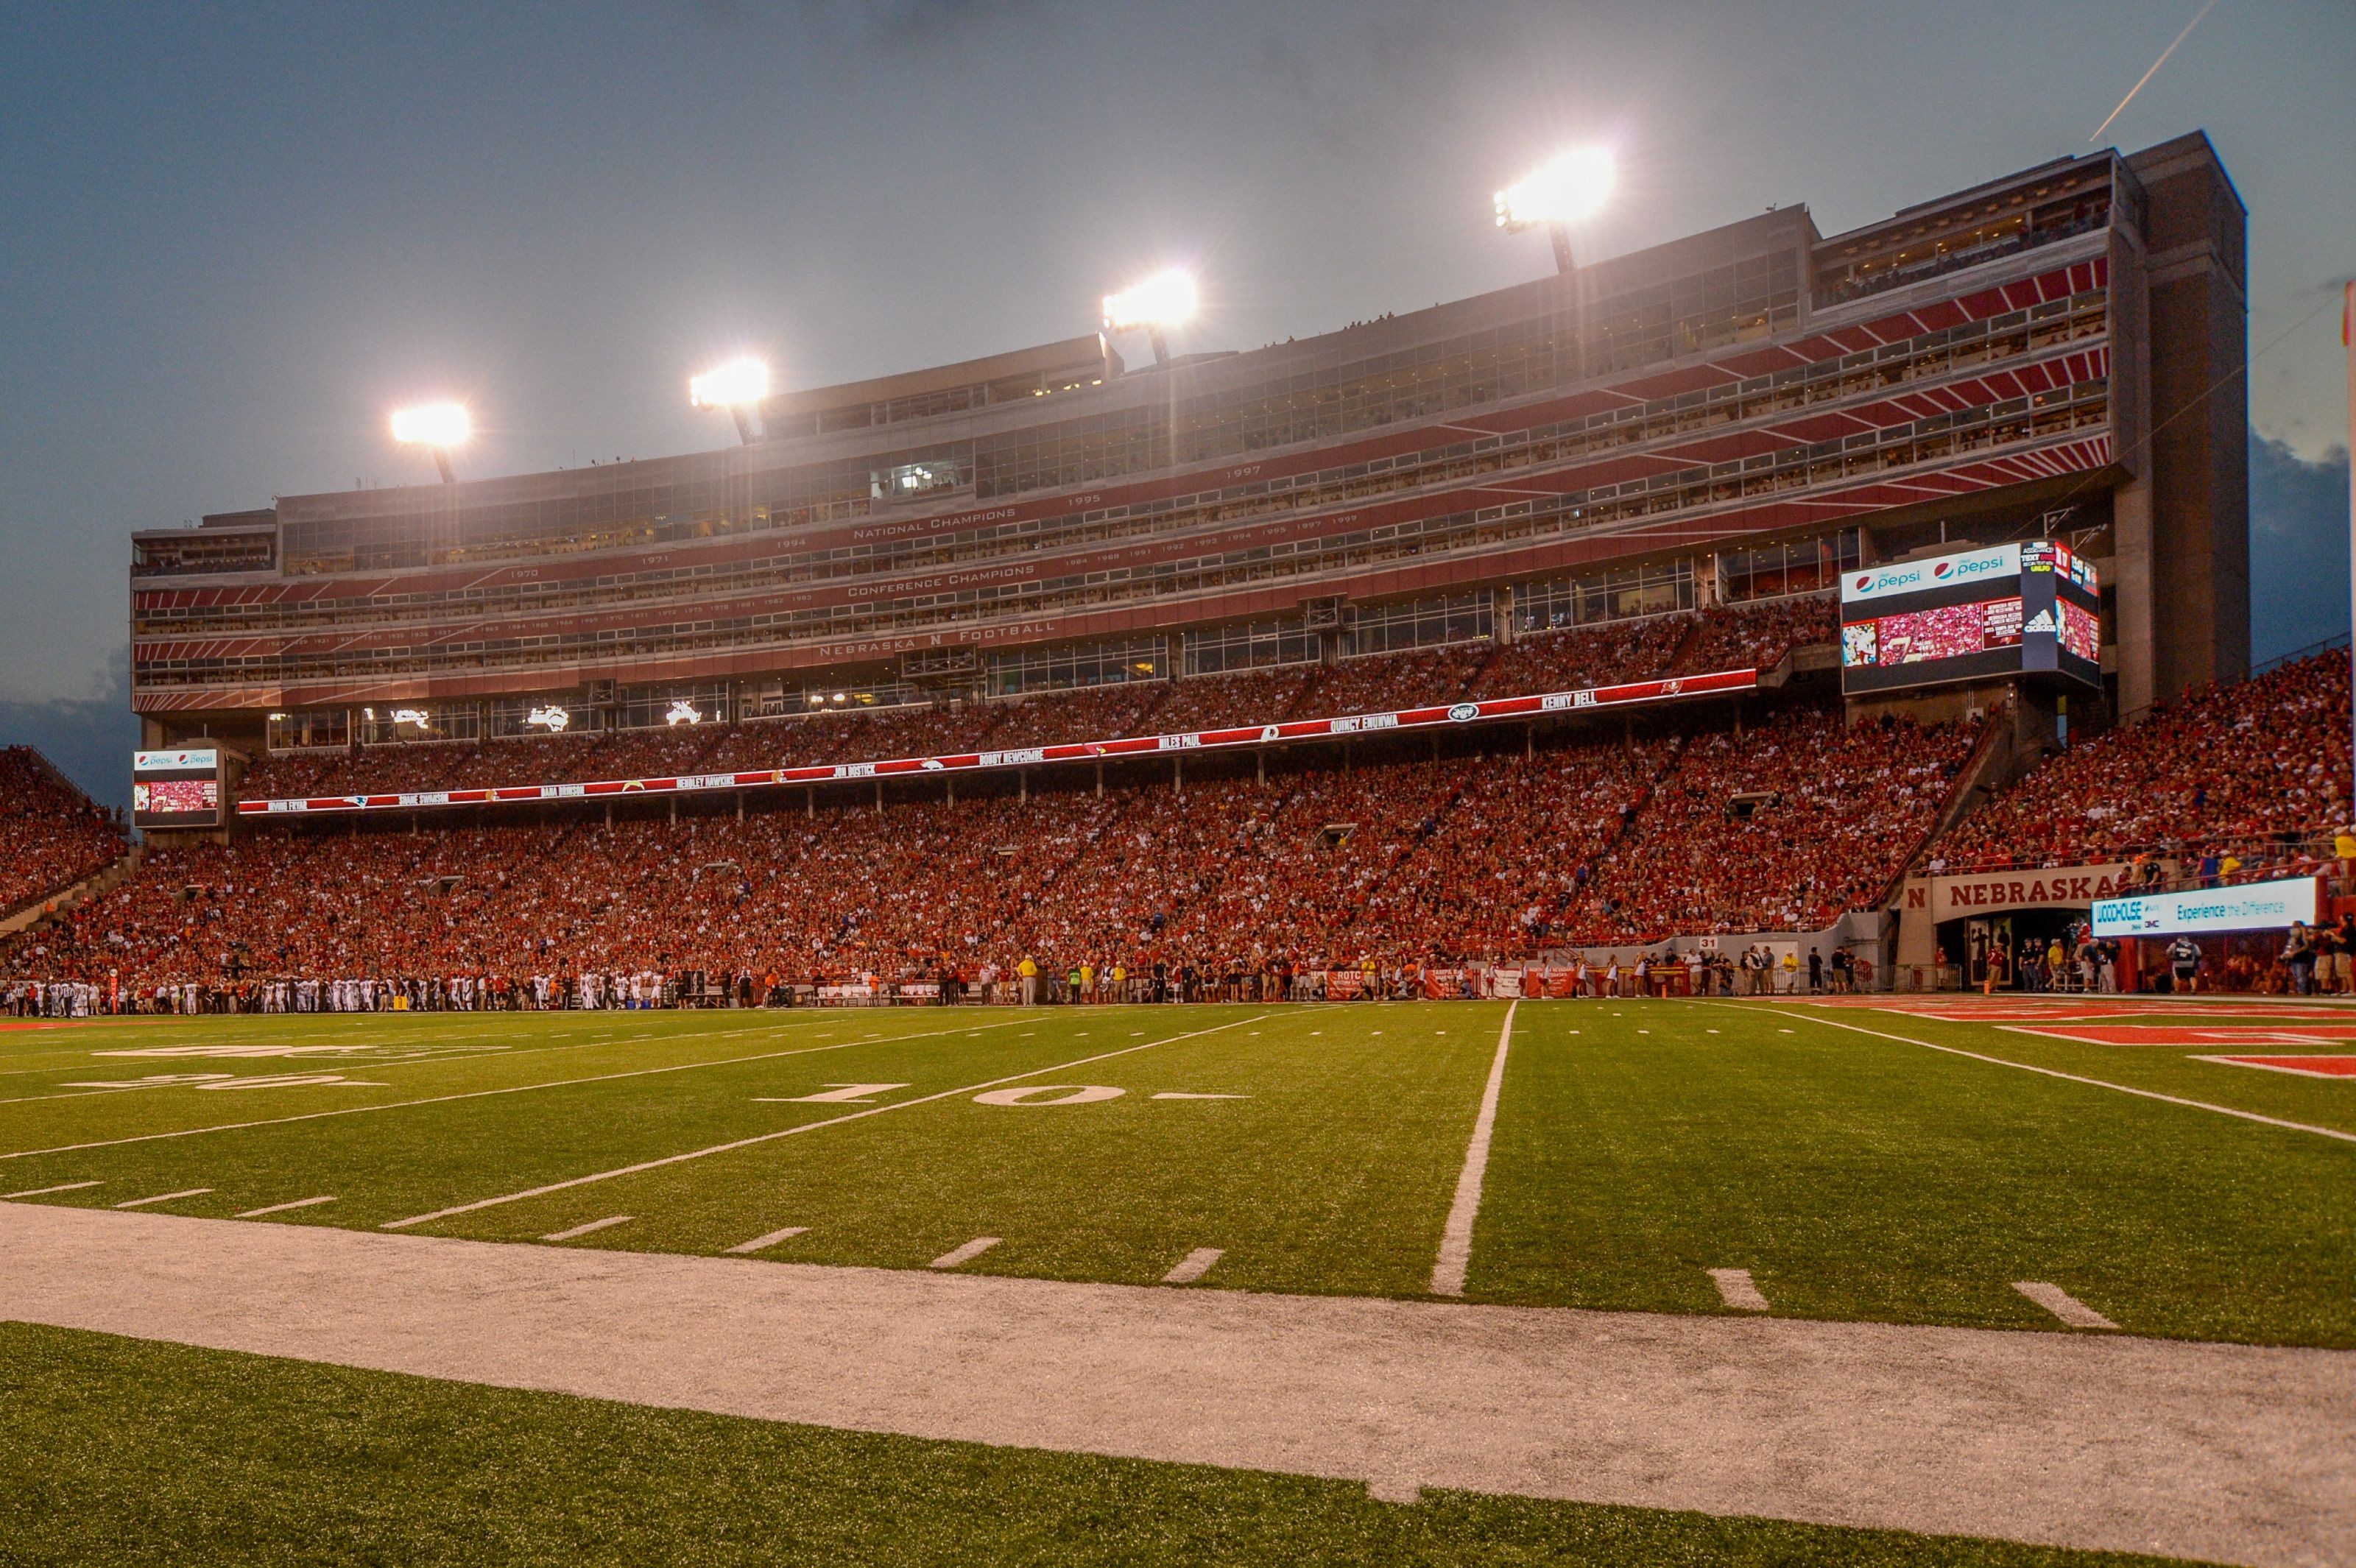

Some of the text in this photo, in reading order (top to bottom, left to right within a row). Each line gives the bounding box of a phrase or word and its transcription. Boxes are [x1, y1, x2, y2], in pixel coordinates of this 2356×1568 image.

[1227, 466, 1260, 478] 1997
[1069, 495, 1101, 506] 1995
[853, 509, 1015, 540] NATIONAL CHAMPIONS
[1228, 533, 1251, 541] 1994
[1297, 521, 1321, 530] 1997
[777, 539, 805, 548] 1994
[642, 556, 669, 565] 1971
[1958, 556, 2003, 576] pepsi
[511, 570, 538, 578] 1970
[848, 565, 1034, 597] CONFERENCE CHAMPIONS
[1878, 571, 1920, 589] pepsi
[819, 623, 1055, 656] NEBRASKA N FOOTBALL
[1330, 714, 1398, 732] QUINCY ENUNWA
[1182, 734, 1201, 747] PAUL
[150, 757, 172, 765] pepsi
[190, 755, 212, 764] pepsi
[1908, 888, 1925, 908] N
[1950, 876, 2120, 906] NEBRASKA
[2177, 903, 2225, 923] Experience
[1701, 939, 1715, 947] 31
[1337, 971, 1361, 980] ROTC
